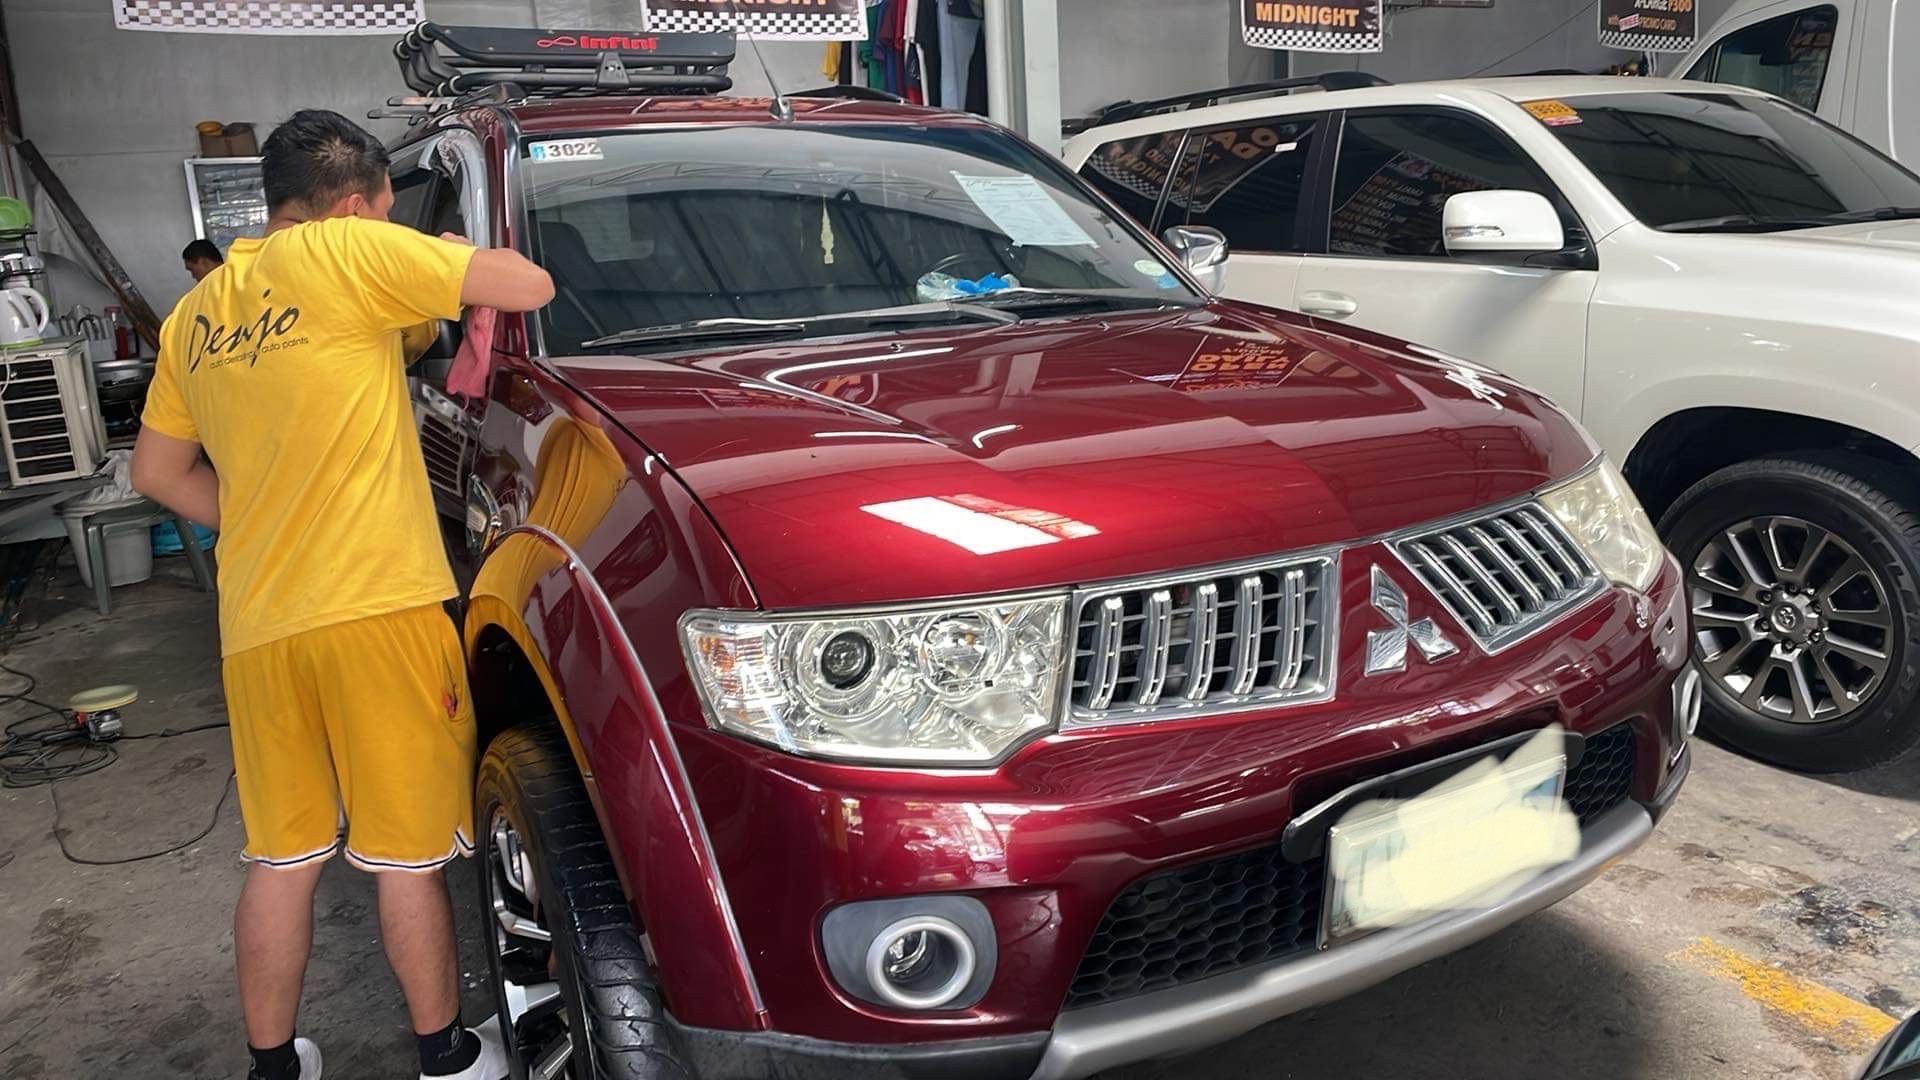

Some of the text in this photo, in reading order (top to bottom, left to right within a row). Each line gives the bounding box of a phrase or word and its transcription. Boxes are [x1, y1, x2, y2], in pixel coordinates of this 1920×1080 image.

[1255, 3, 1360, 27] MIDNIGHT
[261, 343, 281, 353] auto
[282, 336, 309, 349] paints
